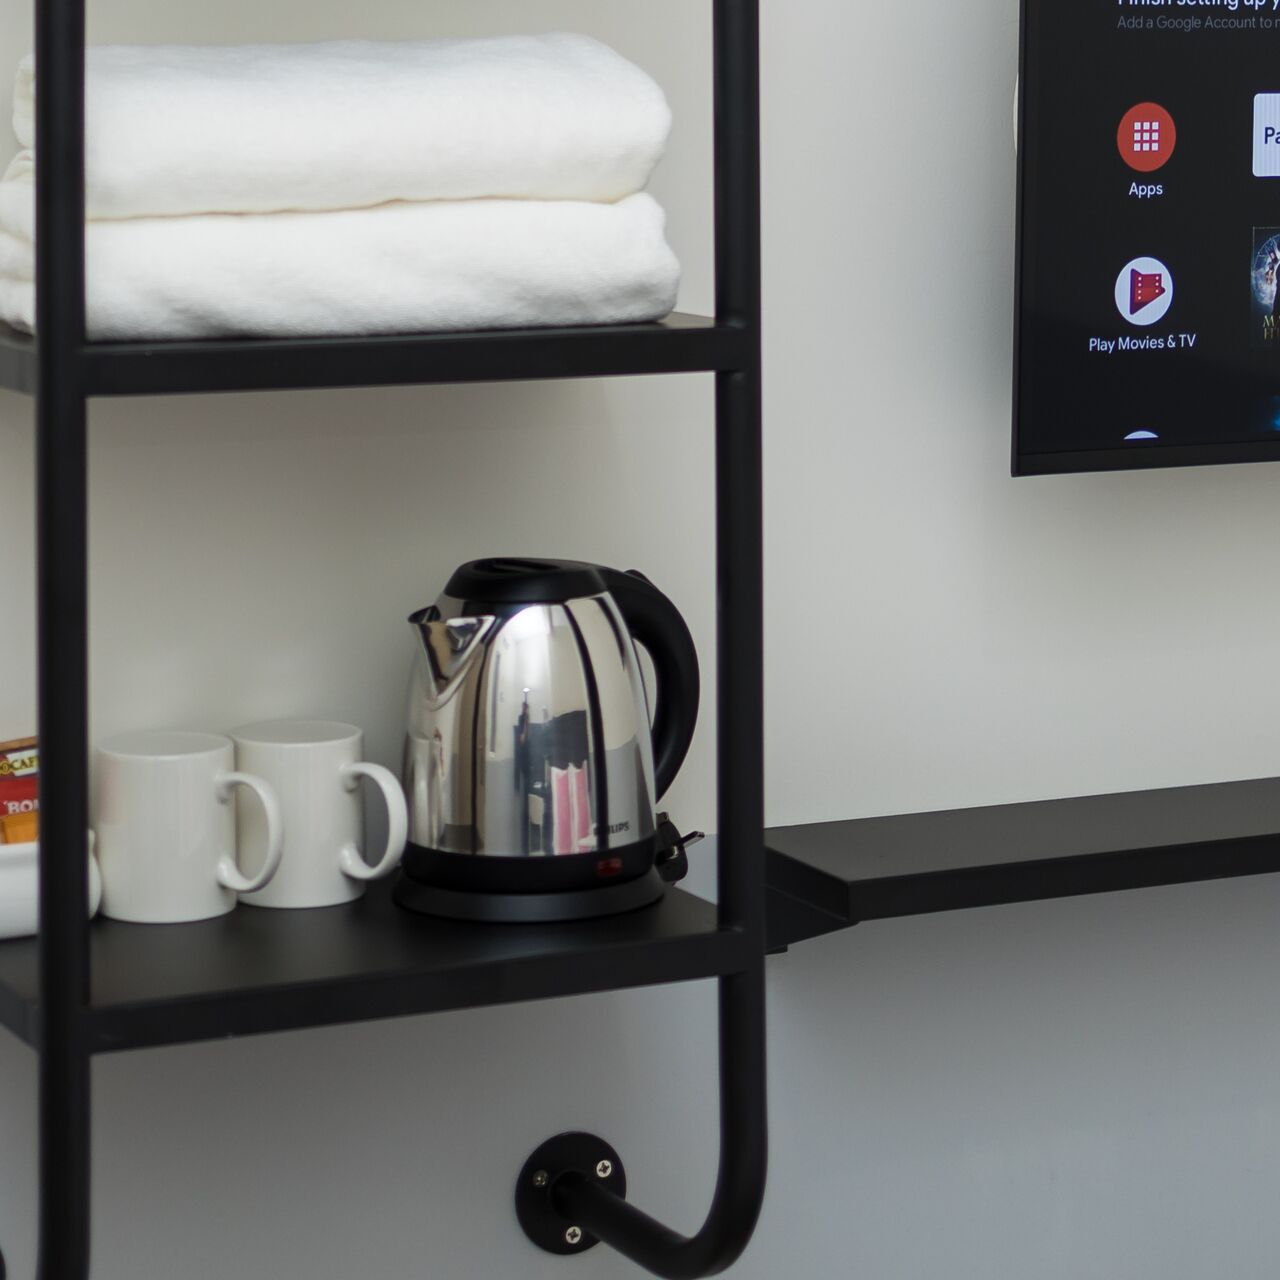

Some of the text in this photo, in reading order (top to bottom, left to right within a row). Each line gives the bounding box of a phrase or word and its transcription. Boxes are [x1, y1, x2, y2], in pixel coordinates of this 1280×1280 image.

[1117, 15, 1143, 30] Add
[1145, 19, 1153, 30] a
[1156, 15, 1201, 32] Google
[1204, 15, 1256, 30] Account
[1259, 16, 1272, 29] to
[1128, 181, 1164, 199] Apps
[1089, 334, 1196, 354] Play Movies & TV
